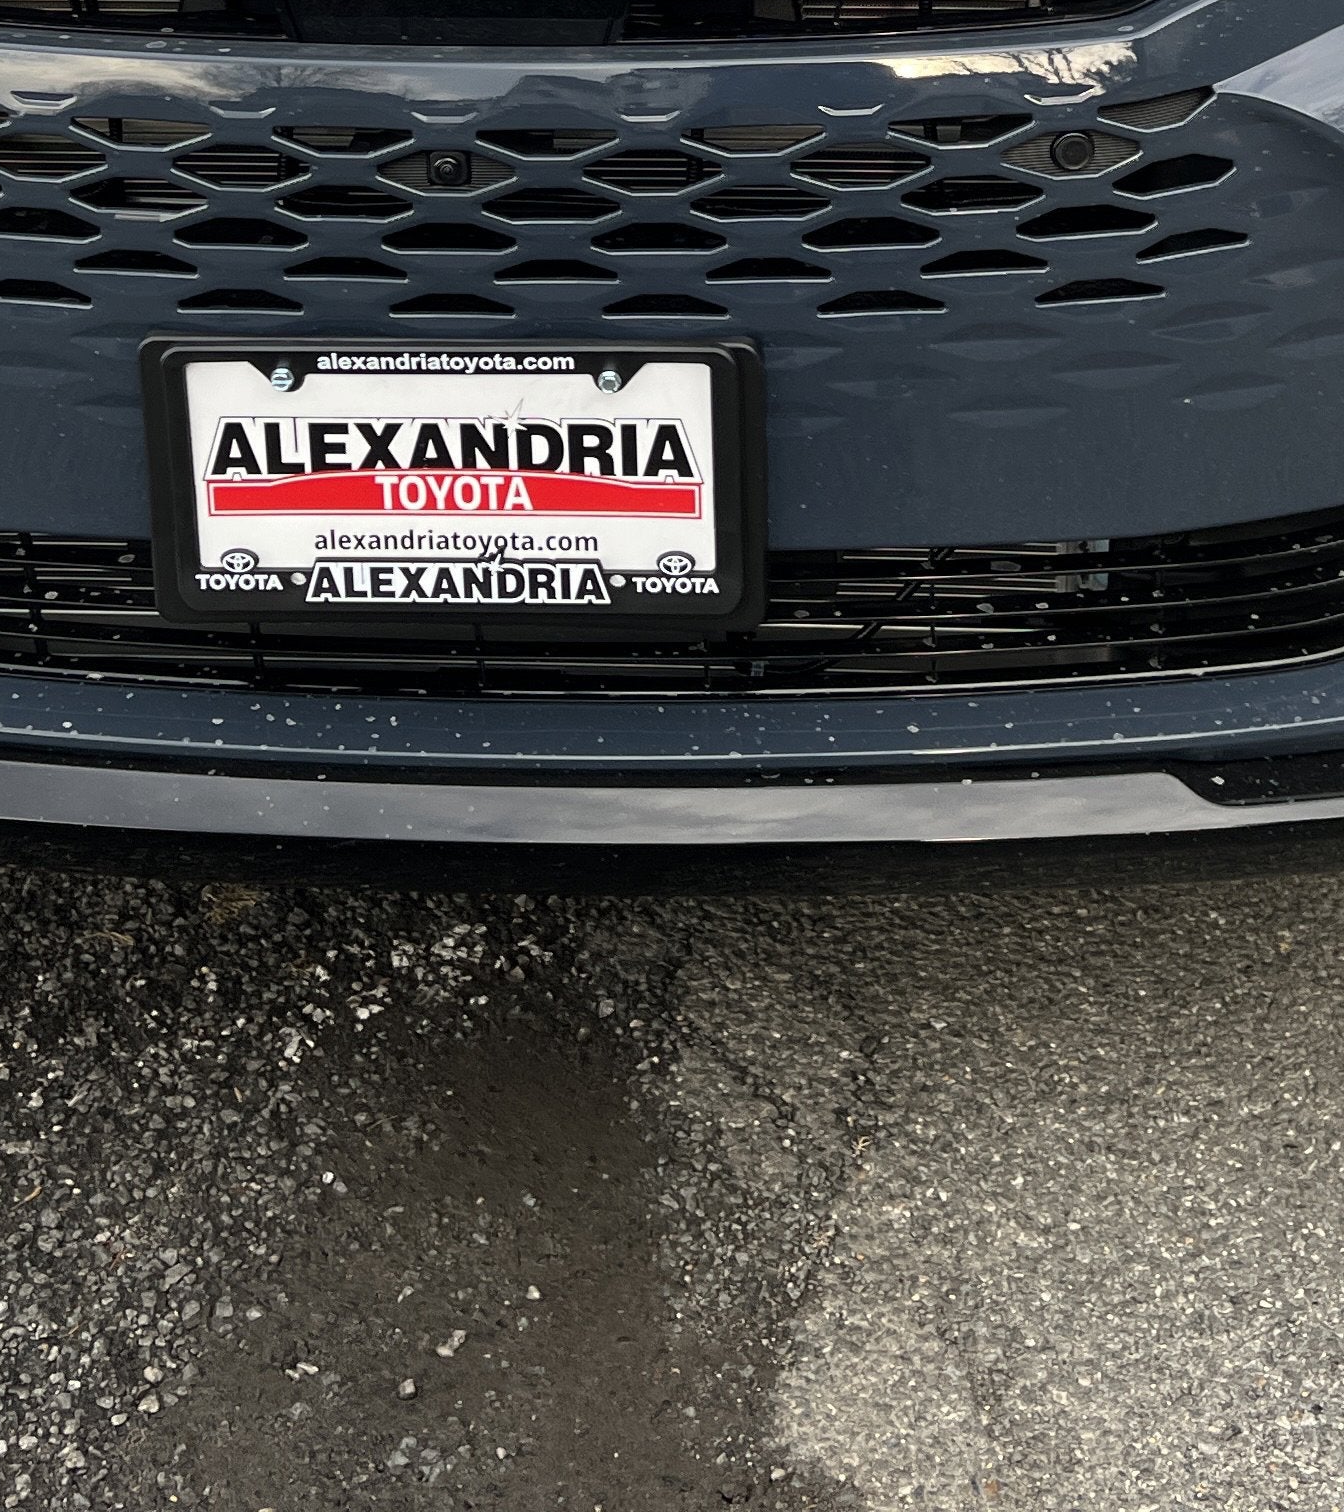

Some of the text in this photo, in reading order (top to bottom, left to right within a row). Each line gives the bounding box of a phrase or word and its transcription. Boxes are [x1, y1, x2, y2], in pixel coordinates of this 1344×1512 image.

[316, 353, 575, 373] alexandriatoyota.com
[208, 418, 698, 479] ALEXANDRIA
[374, 474, 534, 511] TOYOTA
[314, 529, 599, 553] alexandriatoyota.com
[195, 573, 284, 592] TOYOTA
[306, 562, 611, 604] ALEXANDRIA
[632, 575, 719, 595] TOYOTA
